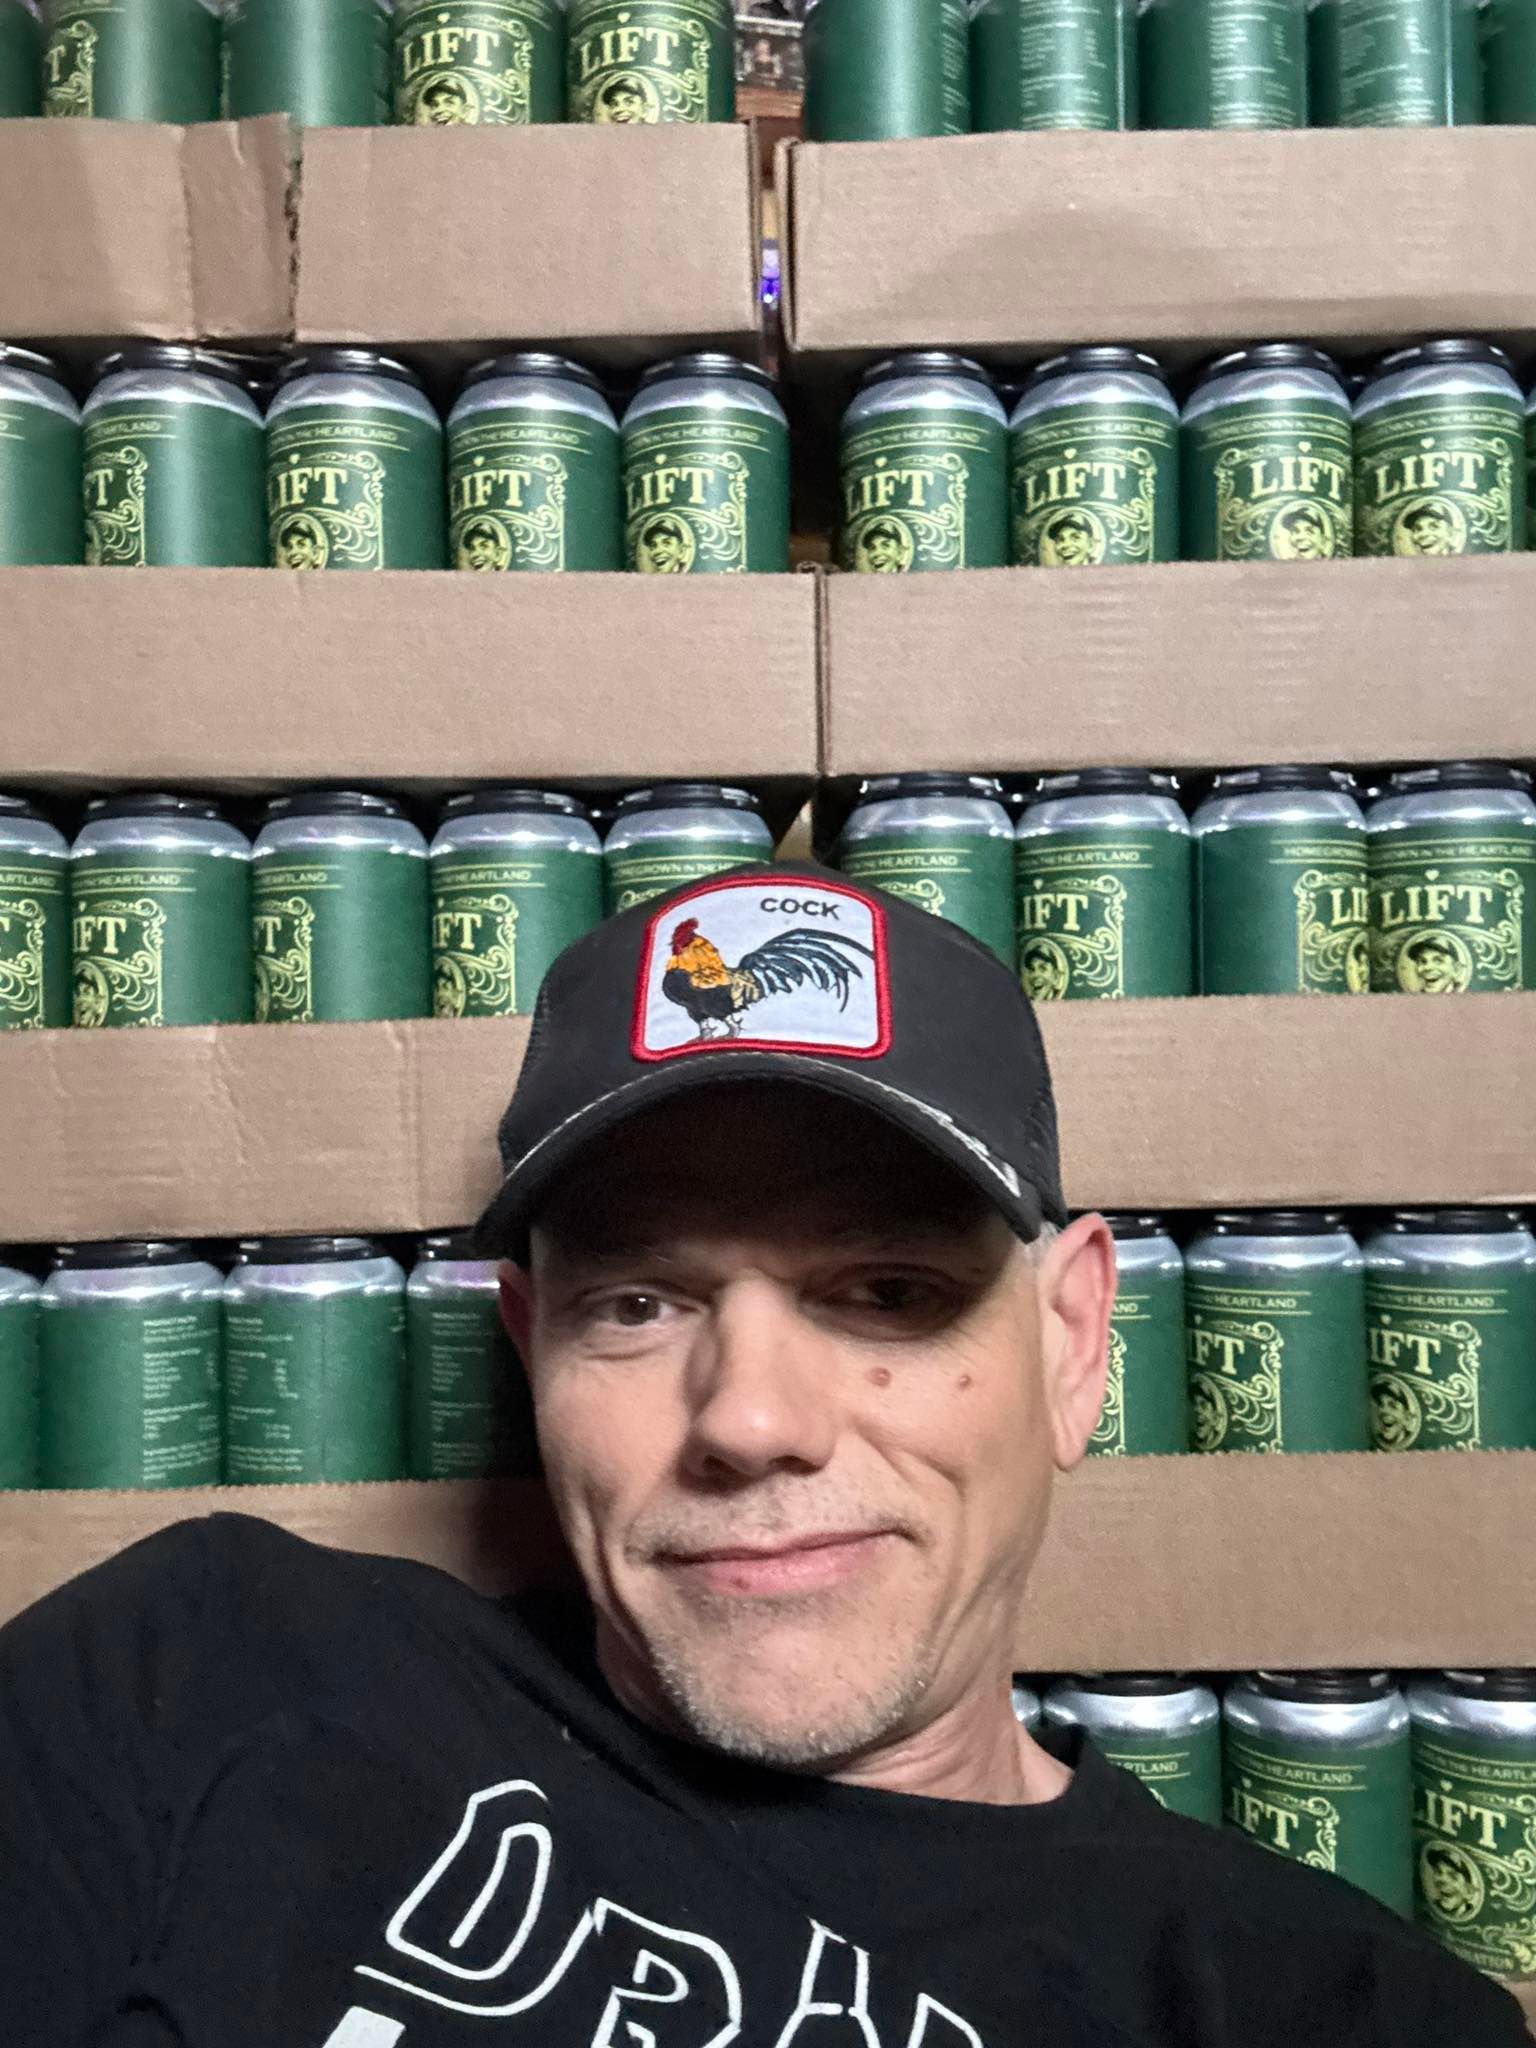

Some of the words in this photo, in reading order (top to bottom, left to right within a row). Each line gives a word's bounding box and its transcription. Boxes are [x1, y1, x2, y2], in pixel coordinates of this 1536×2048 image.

[403, 26, 499, 81] LIFT
[581, 26, 680, 80] LIFT
[1023, 462, 1127, 513] LIFT
[1250, 456, 1346, 500] LIFT
[1375, 451, 1486, 503] LIFT
[879, 855, 959, 868] HEARTLAND
[1058, 851, 1140, 864] HEARTLAND
[760, 897, 841, 921] COCK
[1023, 892, 1089, 932] IFT
[1381, 884, 1493, 929] LIFT
[74, 915, 127, 955] IFT
[432, 912, 482, 951] IFT
[1215, 1294, 1297, 1309] HEARTLAND
[1407, 1294, 1495, 1308] HEARTLAND
[1368, 1327, 1441, 1376] IFT
[1231, 1786, 1300, 1851] IFT
[1424, 1786, 1506, 1851] IFT
